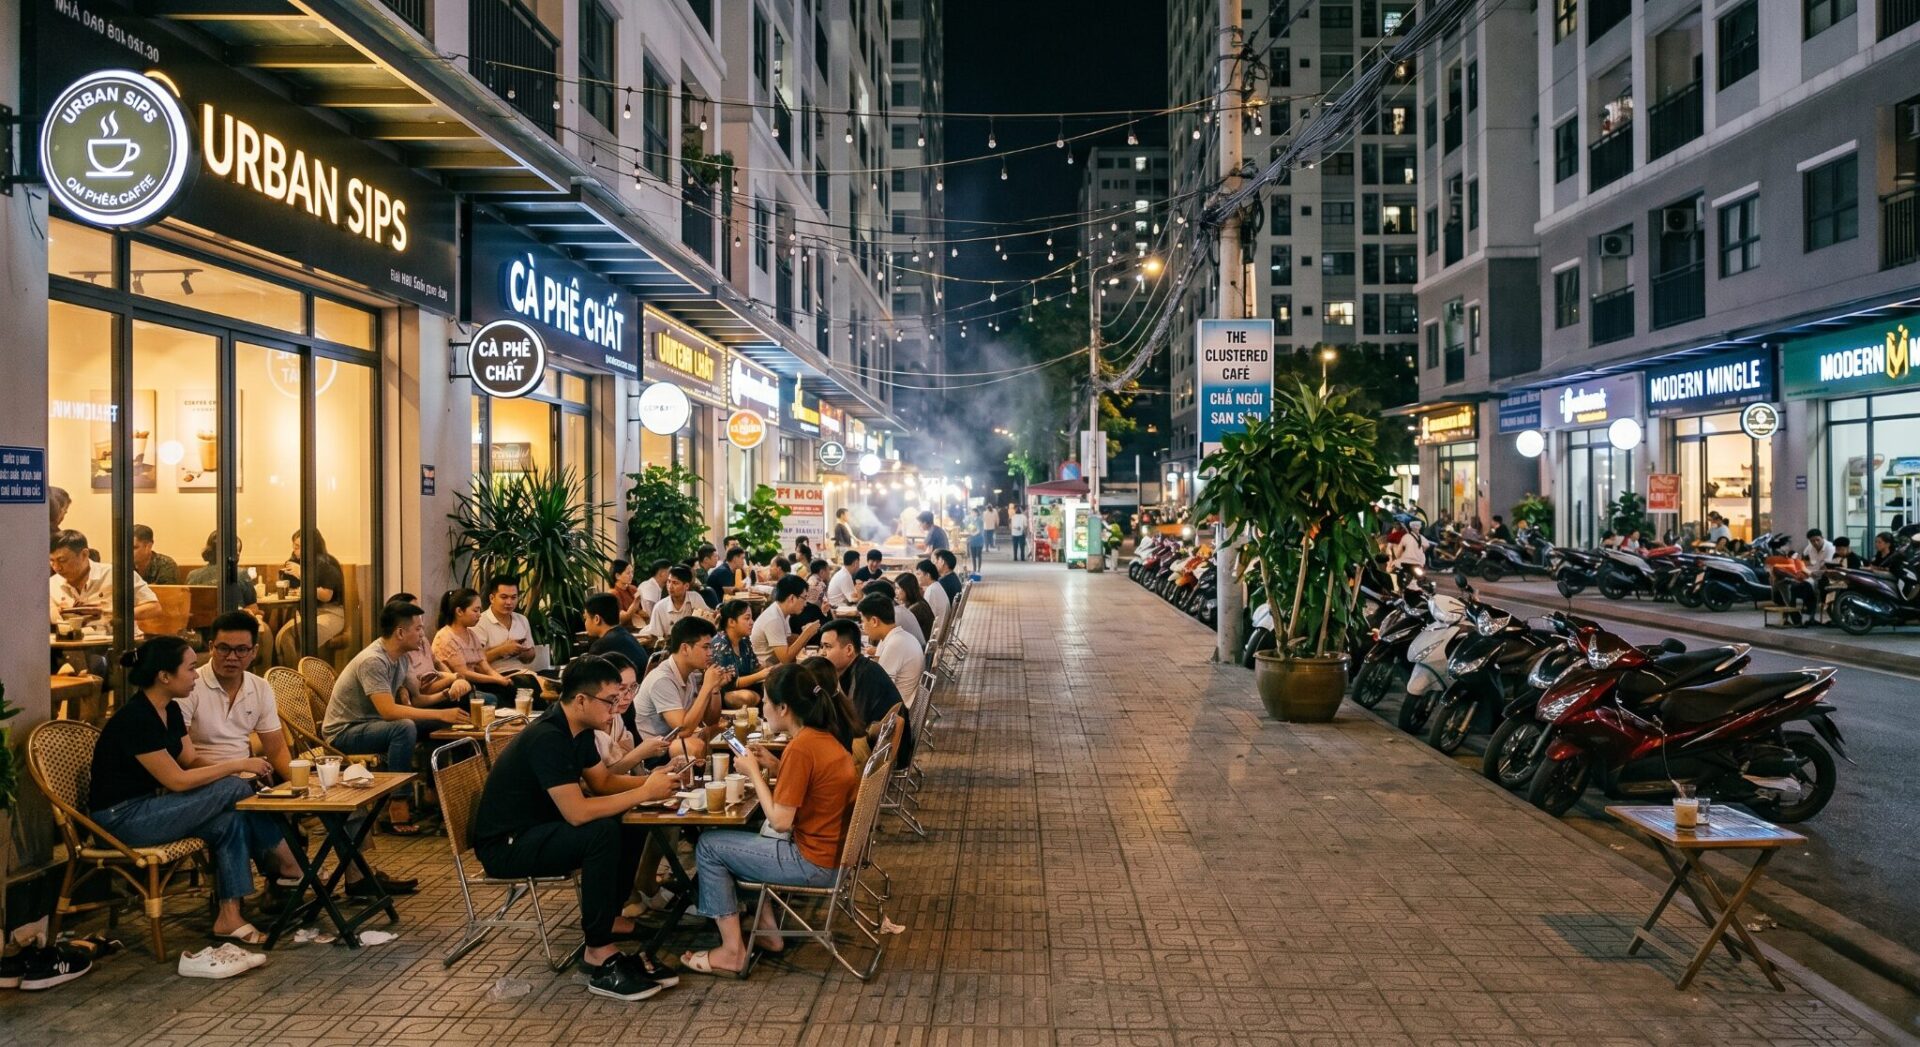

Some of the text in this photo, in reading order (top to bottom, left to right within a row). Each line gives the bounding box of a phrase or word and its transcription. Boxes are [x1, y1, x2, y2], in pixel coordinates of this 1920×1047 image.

[62, 87, 158, 124] URBAN SIPS
[203, 103, 407, 252] URBAN SIPS
[510, 252, 540, 320] CÀ
[543, 277, 580, 336] PHÊ
[583, 293, 624, 352] CHẤT
[478, 337, 531, 357] CÀ PHÊ
[1226, 331, 1247, 344] THE
[485, 358, 525, 381] CHẤT
[1205, 349, 1268, 362] CLUSTERED
[1820, 344, 1885, 382] MODERN
[1651, 359, 1760, 403] MODERN MINGLE
[1210, 411, 1235, 425] SAN
